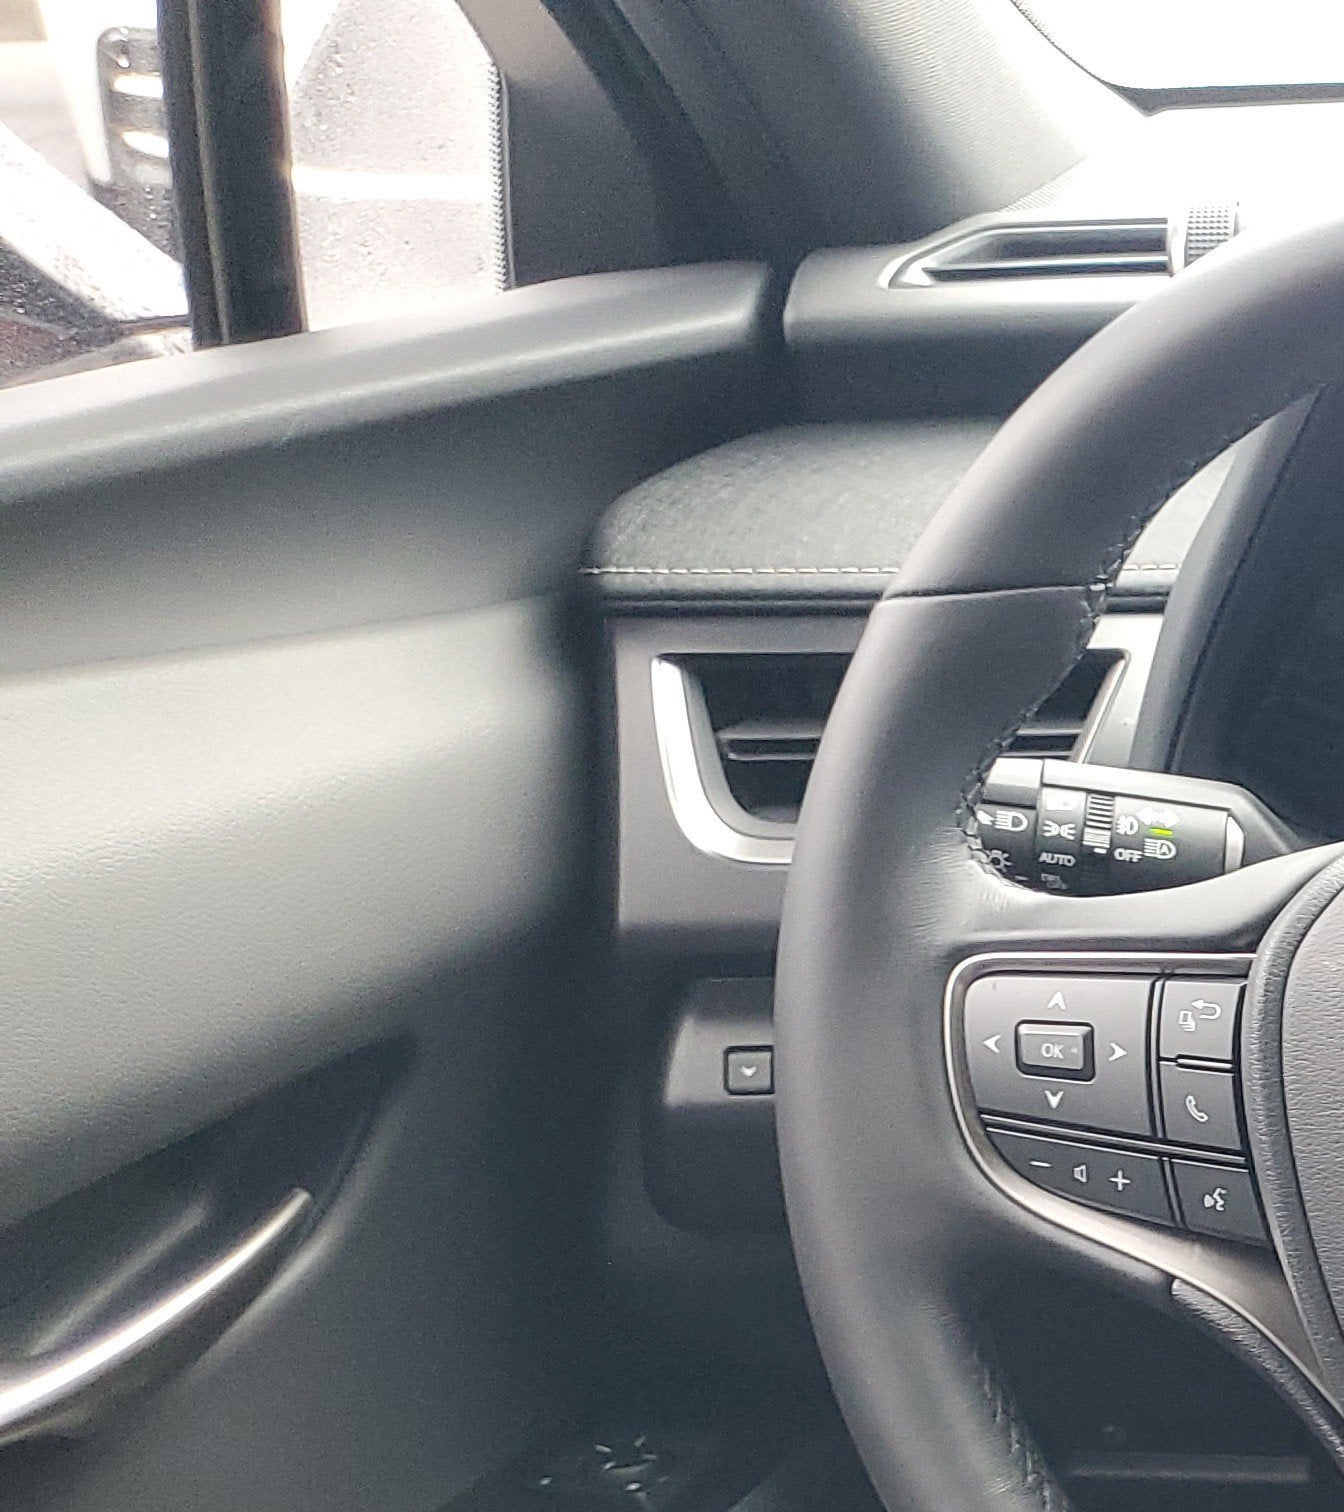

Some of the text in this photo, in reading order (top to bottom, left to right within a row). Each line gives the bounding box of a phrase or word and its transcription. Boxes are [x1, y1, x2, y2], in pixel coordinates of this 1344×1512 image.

[1039, 851, 1075, 868] AUTO
[1114, 848, 1142, 863] OFF
[1040, 1043, 1064, 1059] OK
